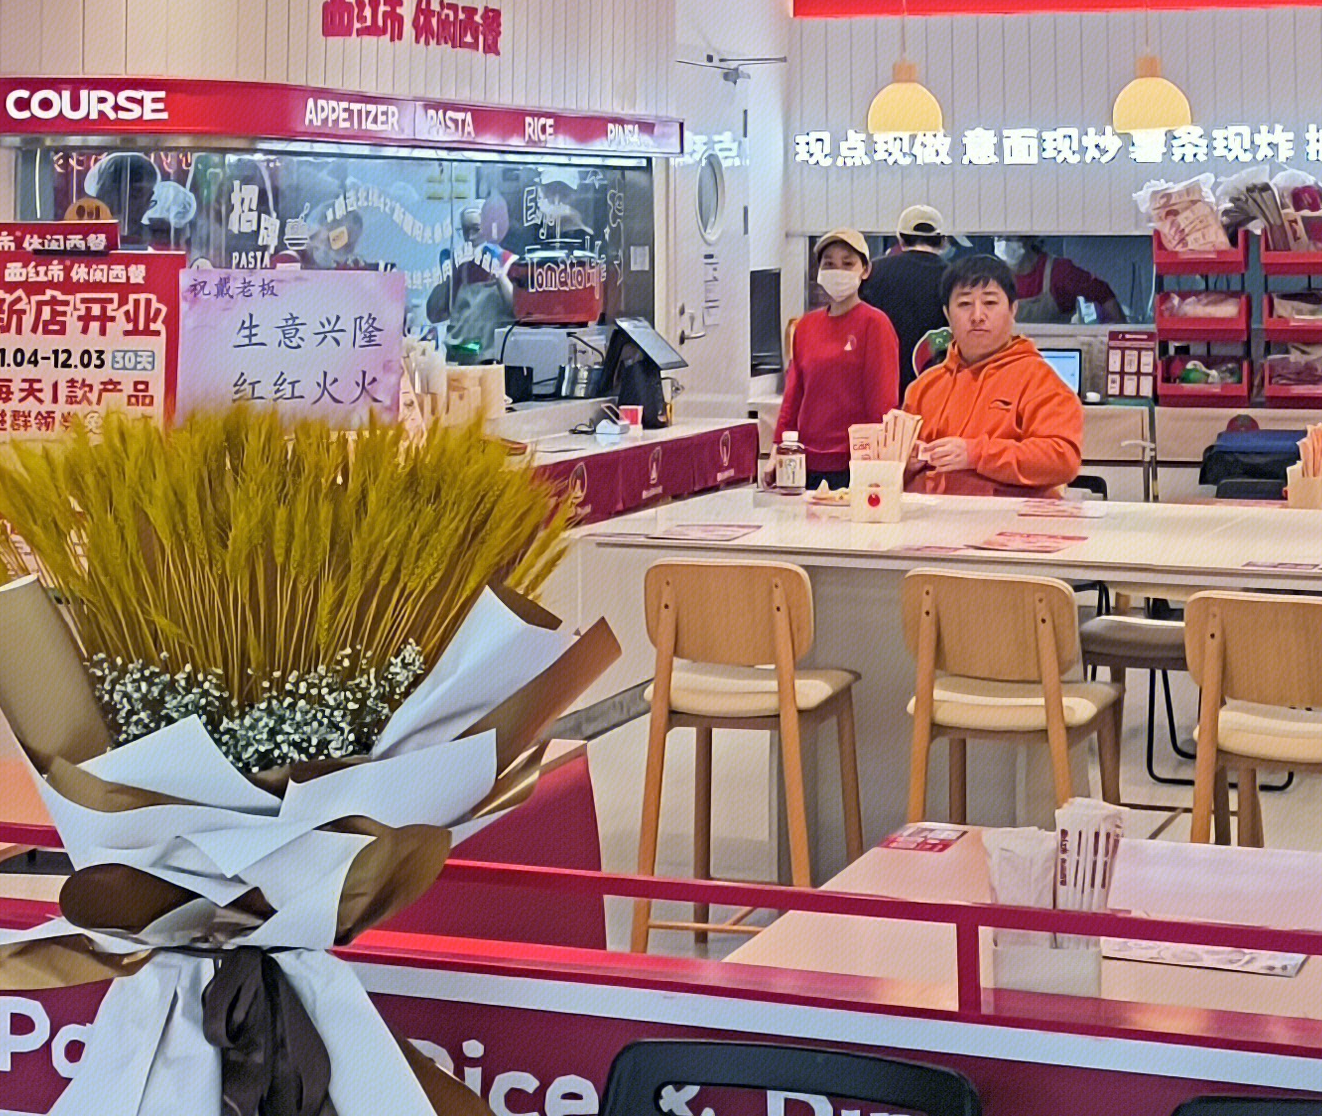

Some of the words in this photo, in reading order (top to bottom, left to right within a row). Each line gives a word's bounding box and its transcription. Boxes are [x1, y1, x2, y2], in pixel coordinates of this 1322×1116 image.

[5, 89, 169, 121] COURSE
[305, 97, 399, 131] APPETIZER
[426, 109, 475, 139] PASTA
[525, 116, 555, 144] RICE
[794, 129, 952, 167] 现点现做
[960, 125, 1123, 166] 意面现炒
[1129, 123, 1295, 163] 薯条现炸
[228, 180, 280, 254] 招牌
[23, 234, 107, 251] 休闲西餐
[5, 260, 64, 282] 西红市
[70, 263, 146, 284] 休闲西餐
[232, 251, 270, 270] PASTA
[233, 313, 384, 349] 生意兴隆
[113, 351, 154, 370] 30天
[232, 370, 383, 405] 红红火火
